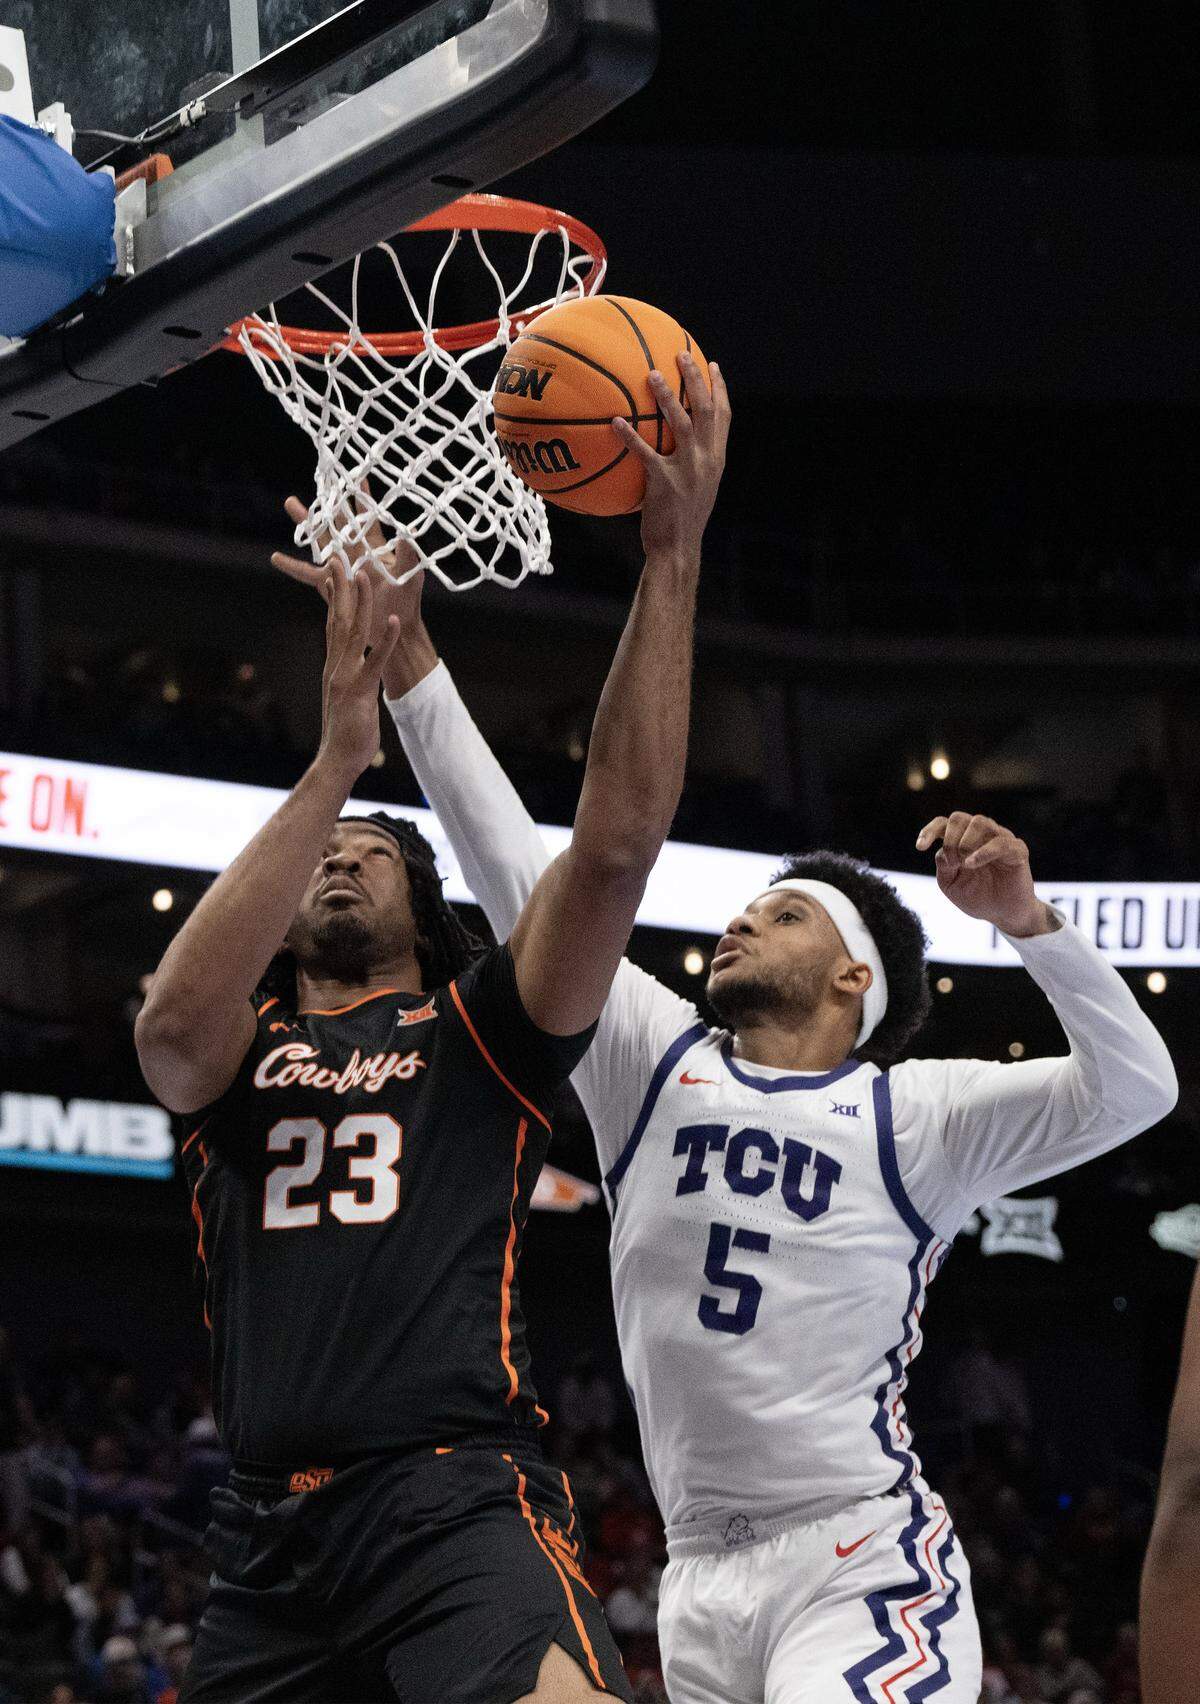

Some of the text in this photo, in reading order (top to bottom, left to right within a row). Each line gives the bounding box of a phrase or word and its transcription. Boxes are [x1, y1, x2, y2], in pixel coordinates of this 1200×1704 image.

[30, 774, 99, 838] ON.
[1165, 897, 1200, 950] U
[254, 1042, 427, 1095] Cowboys
[263, 1113, 403, 1230] 23
[673, 1123, 843, 1223] TCU
[698, 1222, 771, 1336] 5
